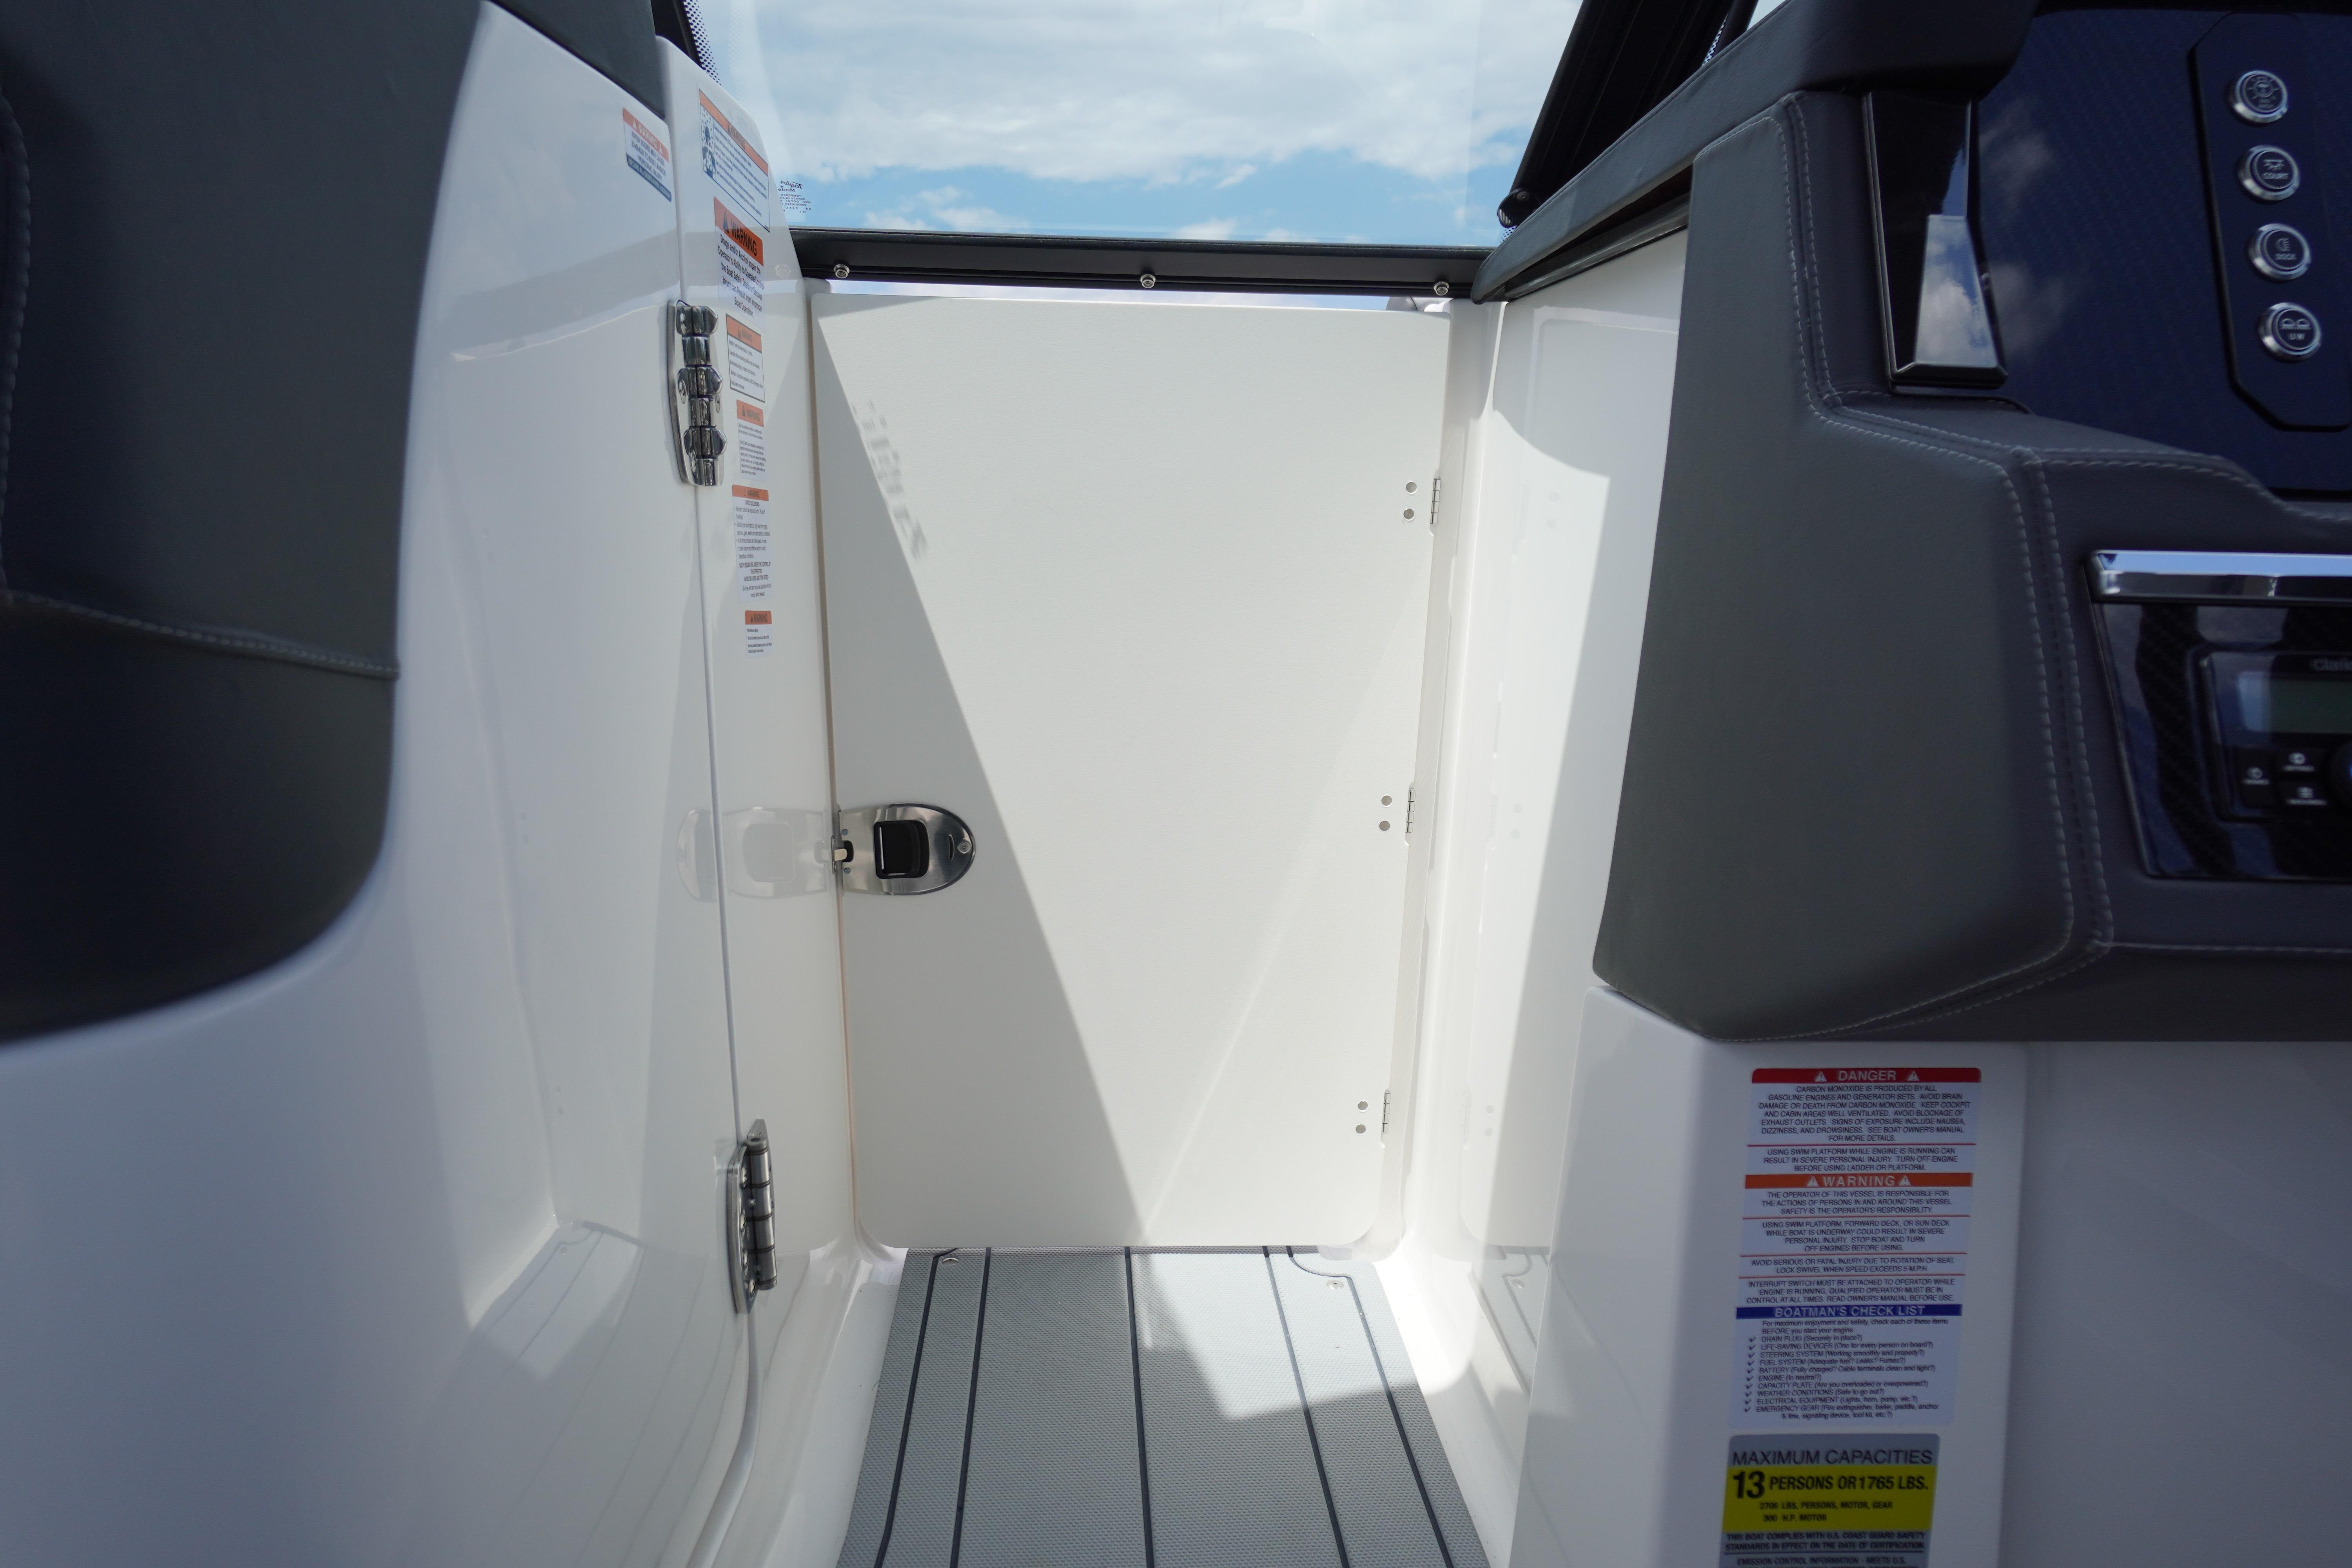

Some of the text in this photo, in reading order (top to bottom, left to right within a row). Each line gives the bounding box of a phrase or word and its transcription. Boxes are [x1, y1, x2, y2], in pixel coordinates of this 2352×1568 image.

[731, 220, 757, 256] WARNING
[720, 234, 730, 250] Drugs
[739, 250, 748, 265] Alcohol
[718, 245, 733, 265] Operator's
[742, 266, 745, 274] to
[722, 275, 731, 290] Injury
[1837, 1070, 1897, 1080] DANGER
[1823, 1176, 1895, 1186] WARNING
[1774, 1306, 1926, 1317] BOATMAN'S CHECK LIST
[1733, 1450, 1932, 1465] MAXIMUM CAPACITIES
[1733, 1471, 1765, 1498] 13
[1769, 1476, 1928, 1489] PERSONS OR 1765 LBS.
